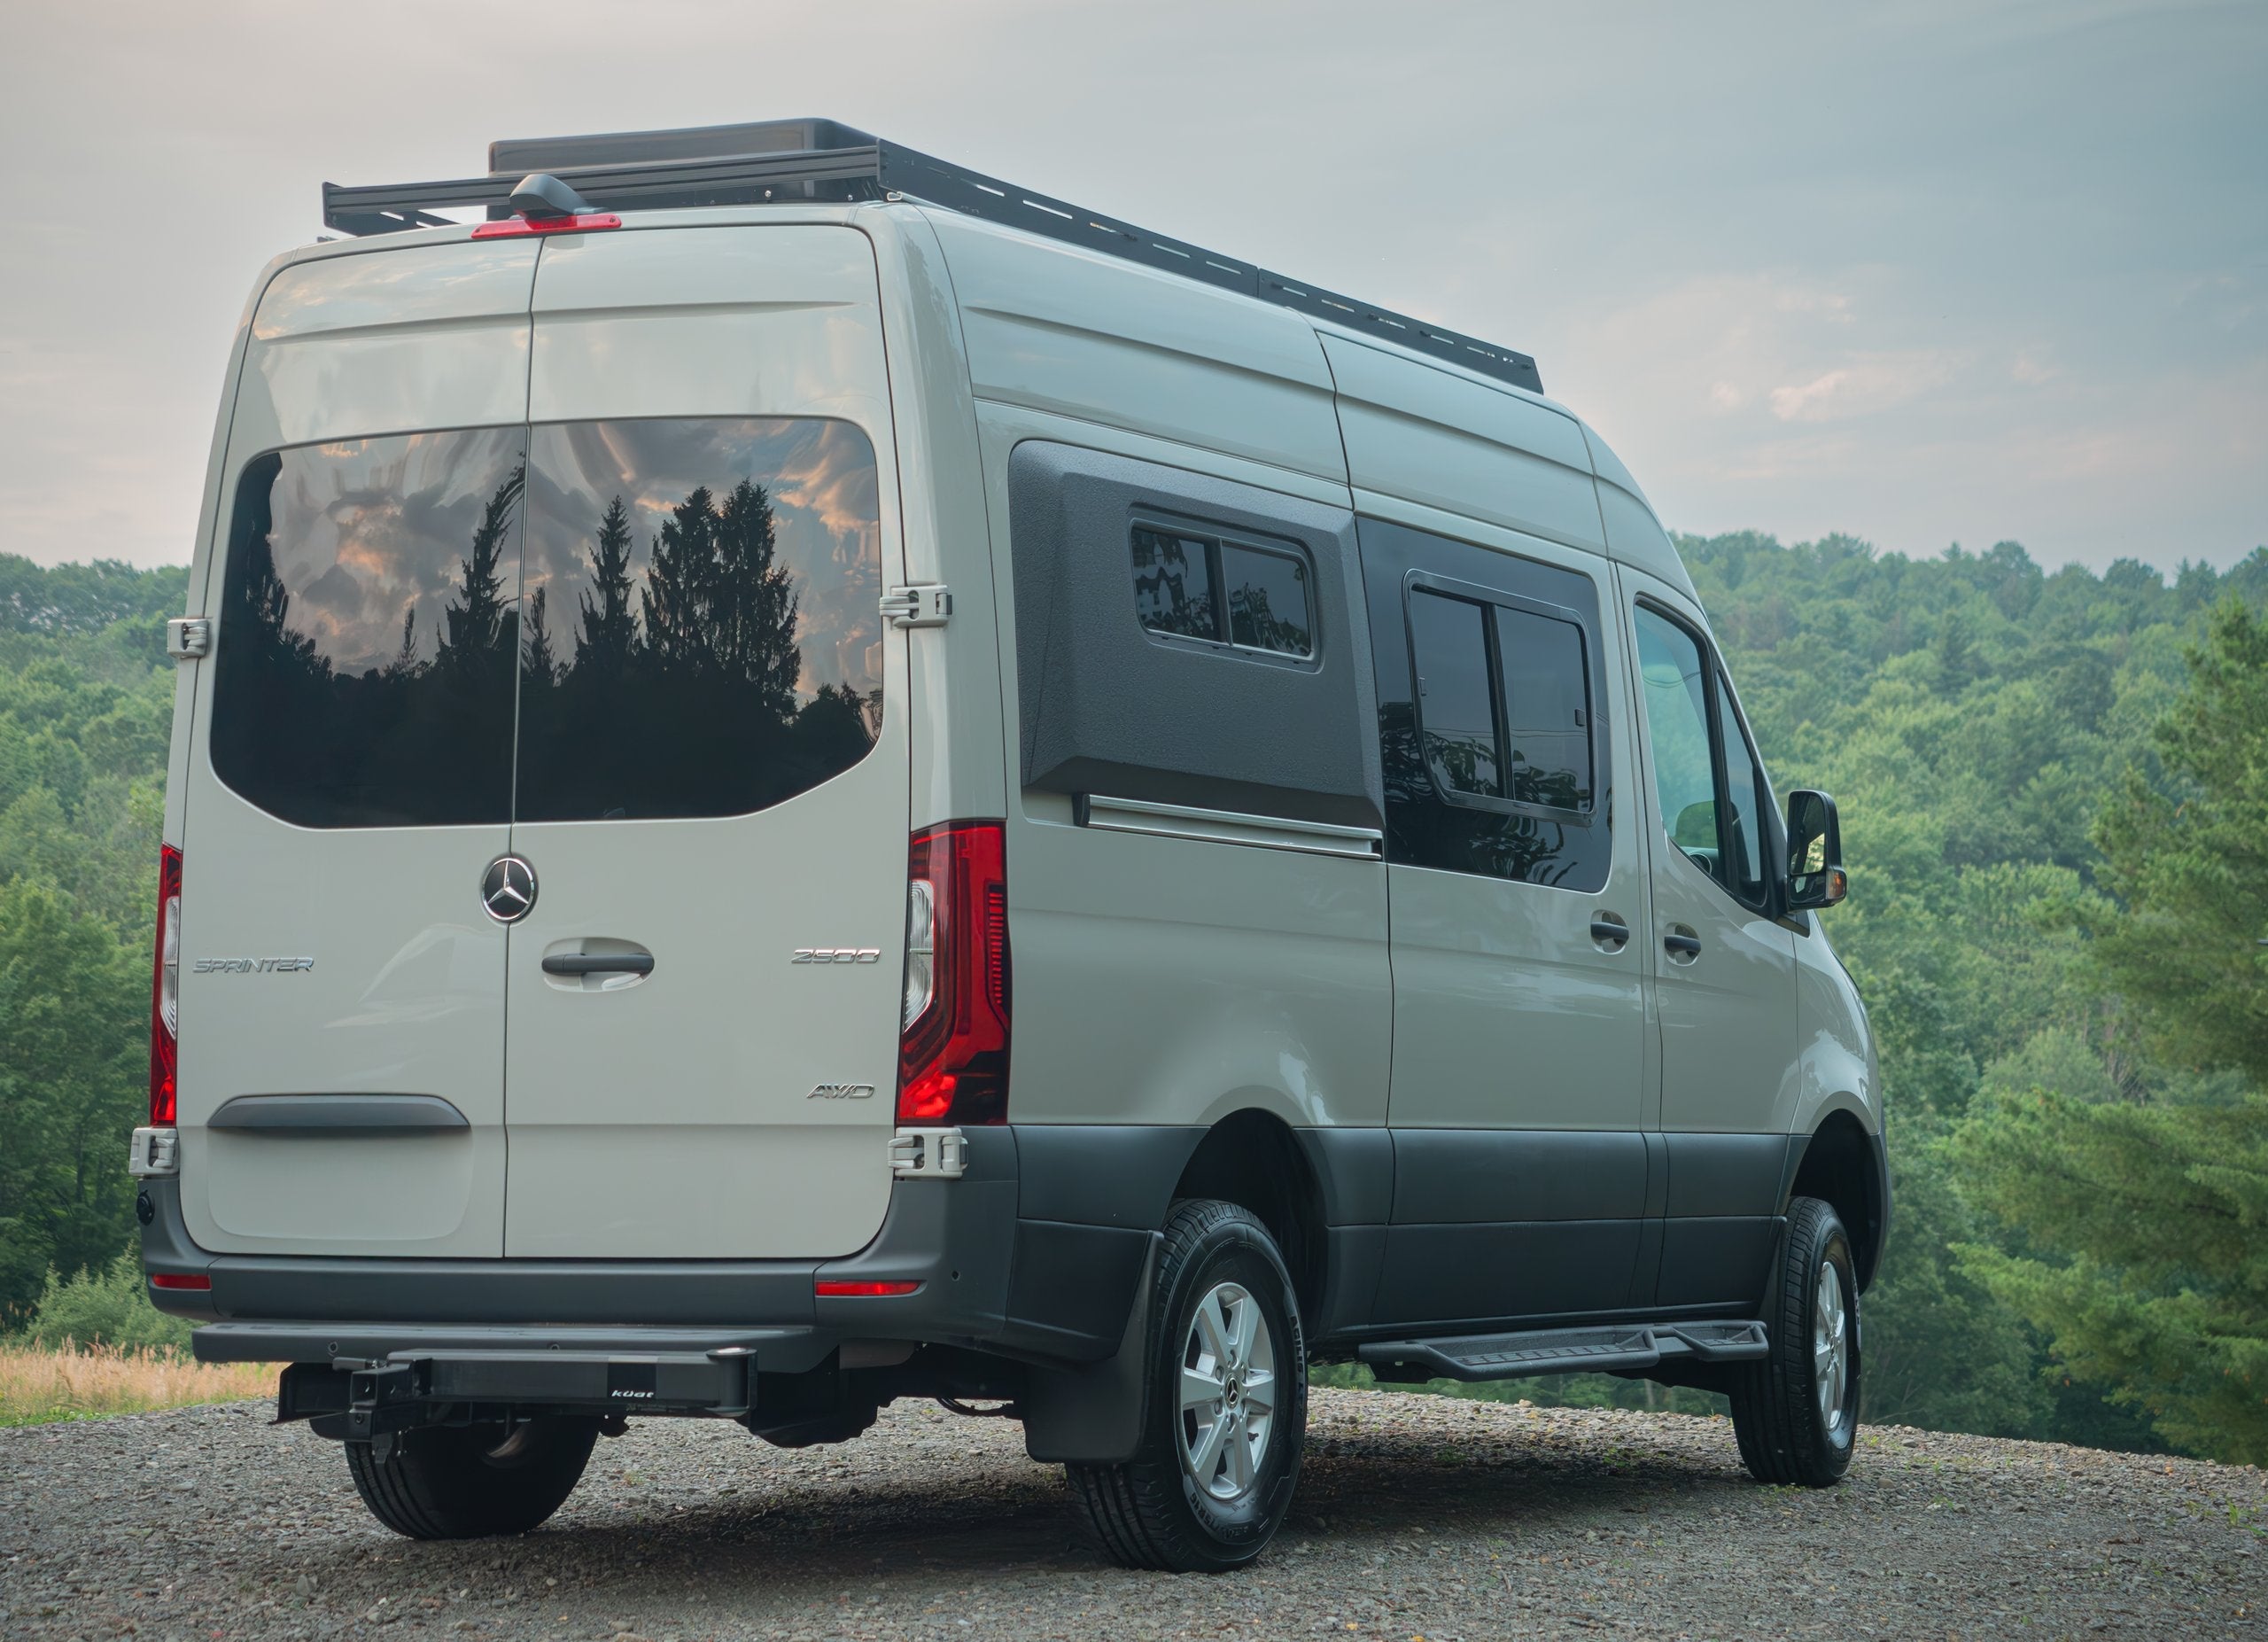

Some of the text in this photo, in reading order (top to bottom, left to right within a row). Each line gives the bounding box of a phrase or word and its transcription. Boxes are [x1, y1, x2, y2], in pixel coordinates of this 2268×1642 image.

[790, 948, 881, 964] 2500
[192, 956, 315, 974] SPRINTER
[806, 1083, 875, 1099] AWD
